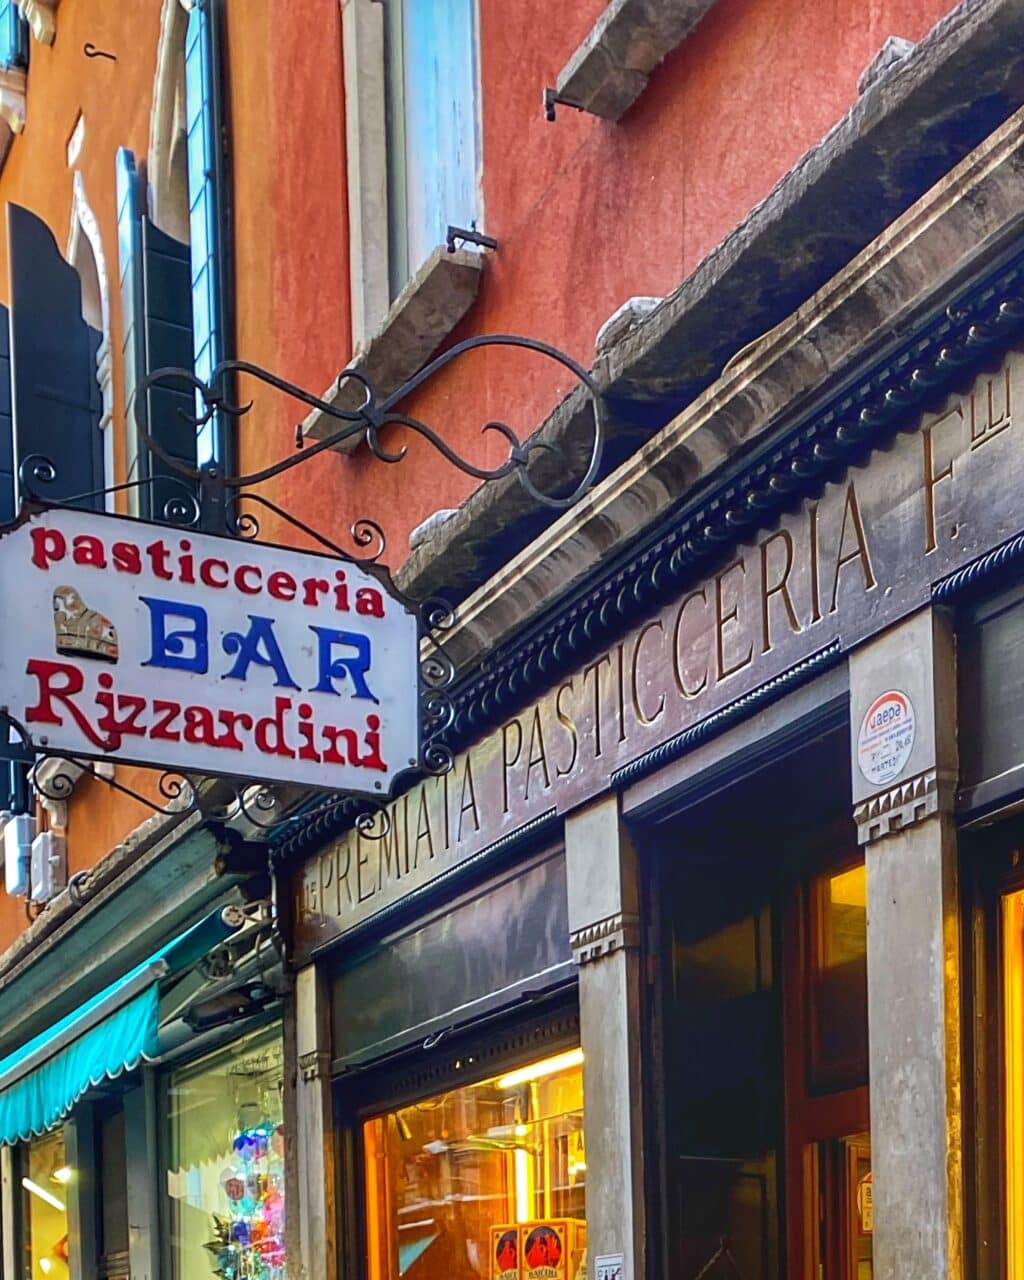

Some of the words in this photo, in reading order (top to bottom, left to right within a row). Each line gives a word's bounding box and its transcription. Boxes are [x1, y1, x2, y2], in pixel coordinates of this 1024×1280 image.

[30, 525, 386, 619] pasticceria
[138, 595, 380, 705] BAR
[319, 752, 481, 926] PREMIATA
[500, 481, 878, 815] PASTICCERIA
[26, 658, 388, 772] Rizzardini
